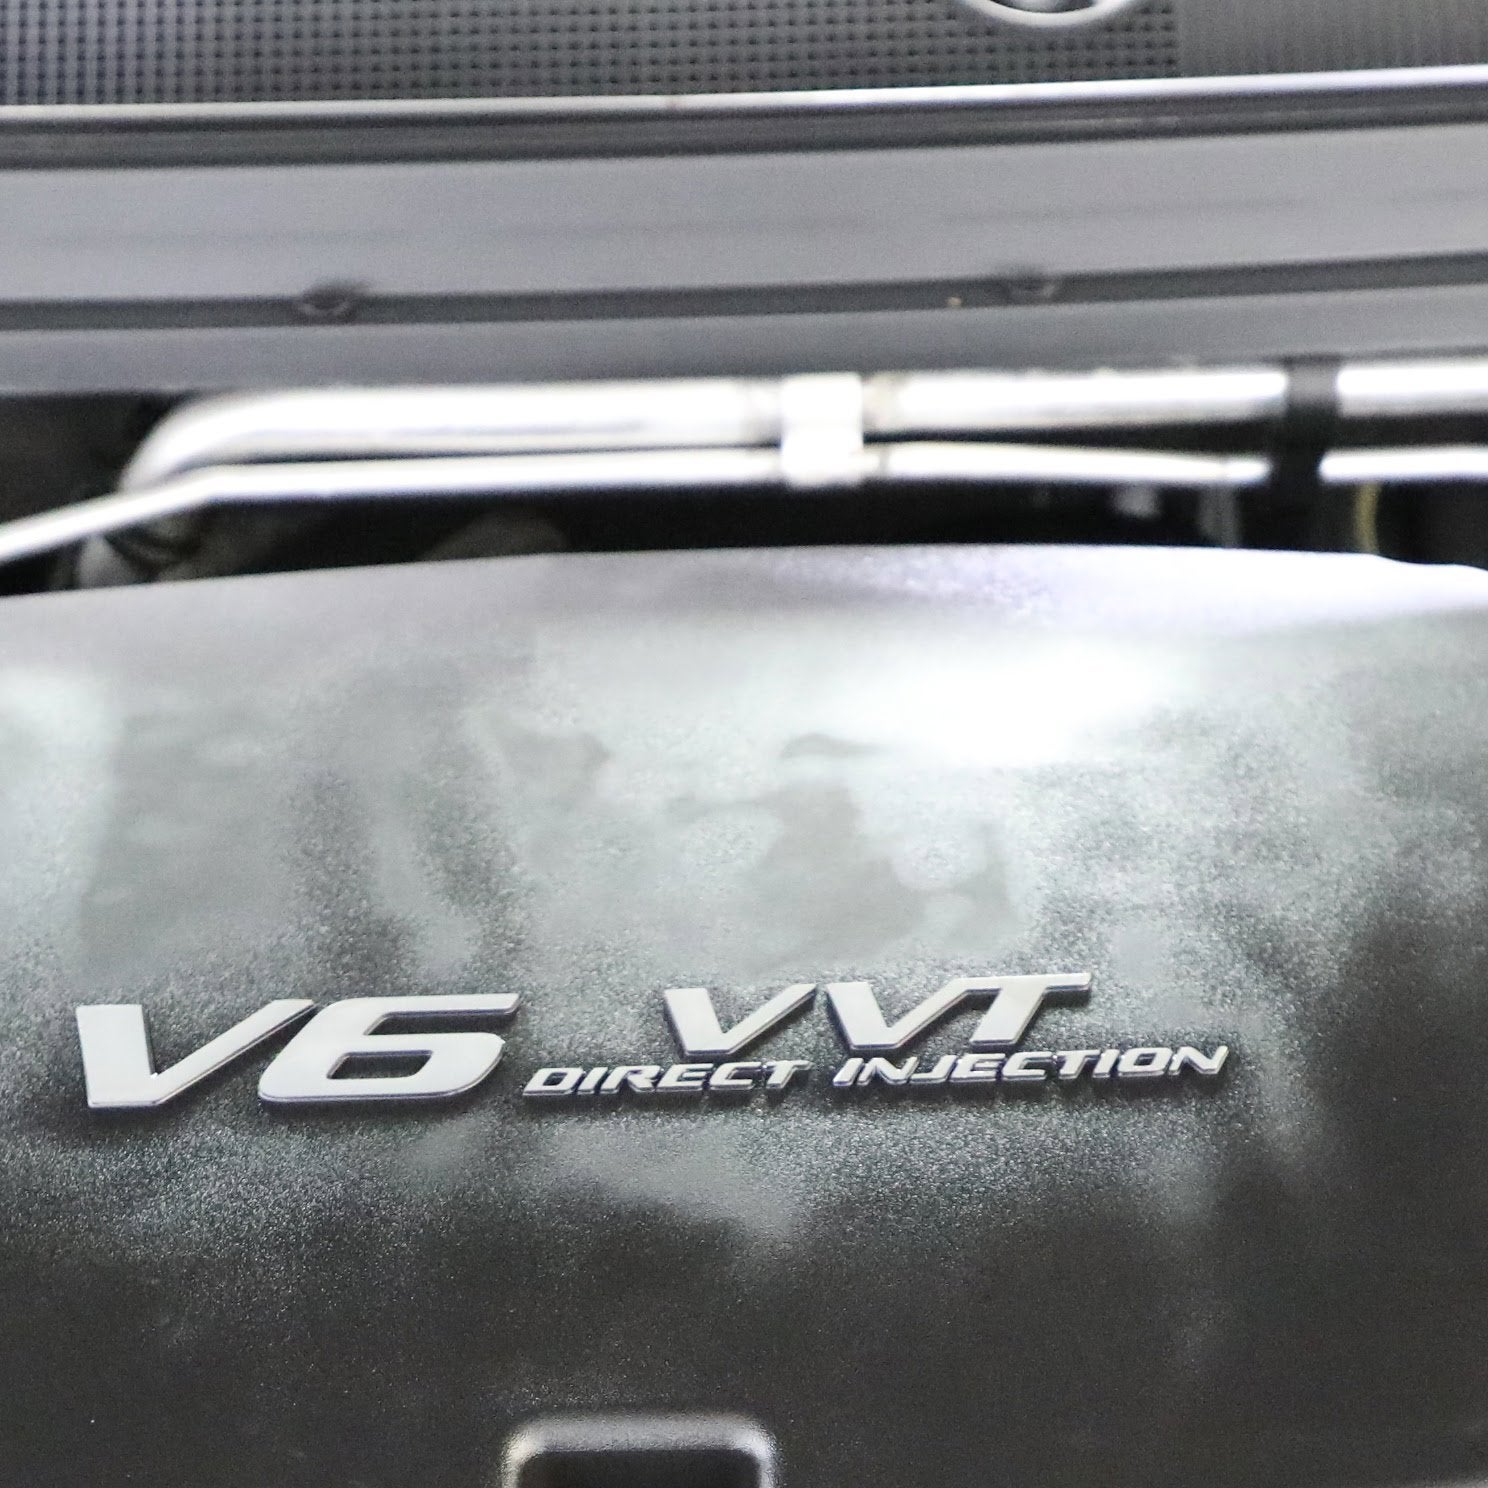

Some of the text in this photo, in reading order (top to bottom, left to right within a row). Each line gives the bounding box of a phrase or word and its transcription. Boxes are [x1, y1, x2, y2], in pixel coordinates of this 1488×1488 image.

[75, 992, 520, 1108] V6
[664, 973, 1093, 1057] VVT
[522, 1045, 1230, 1097] DIRECT INJECTION
